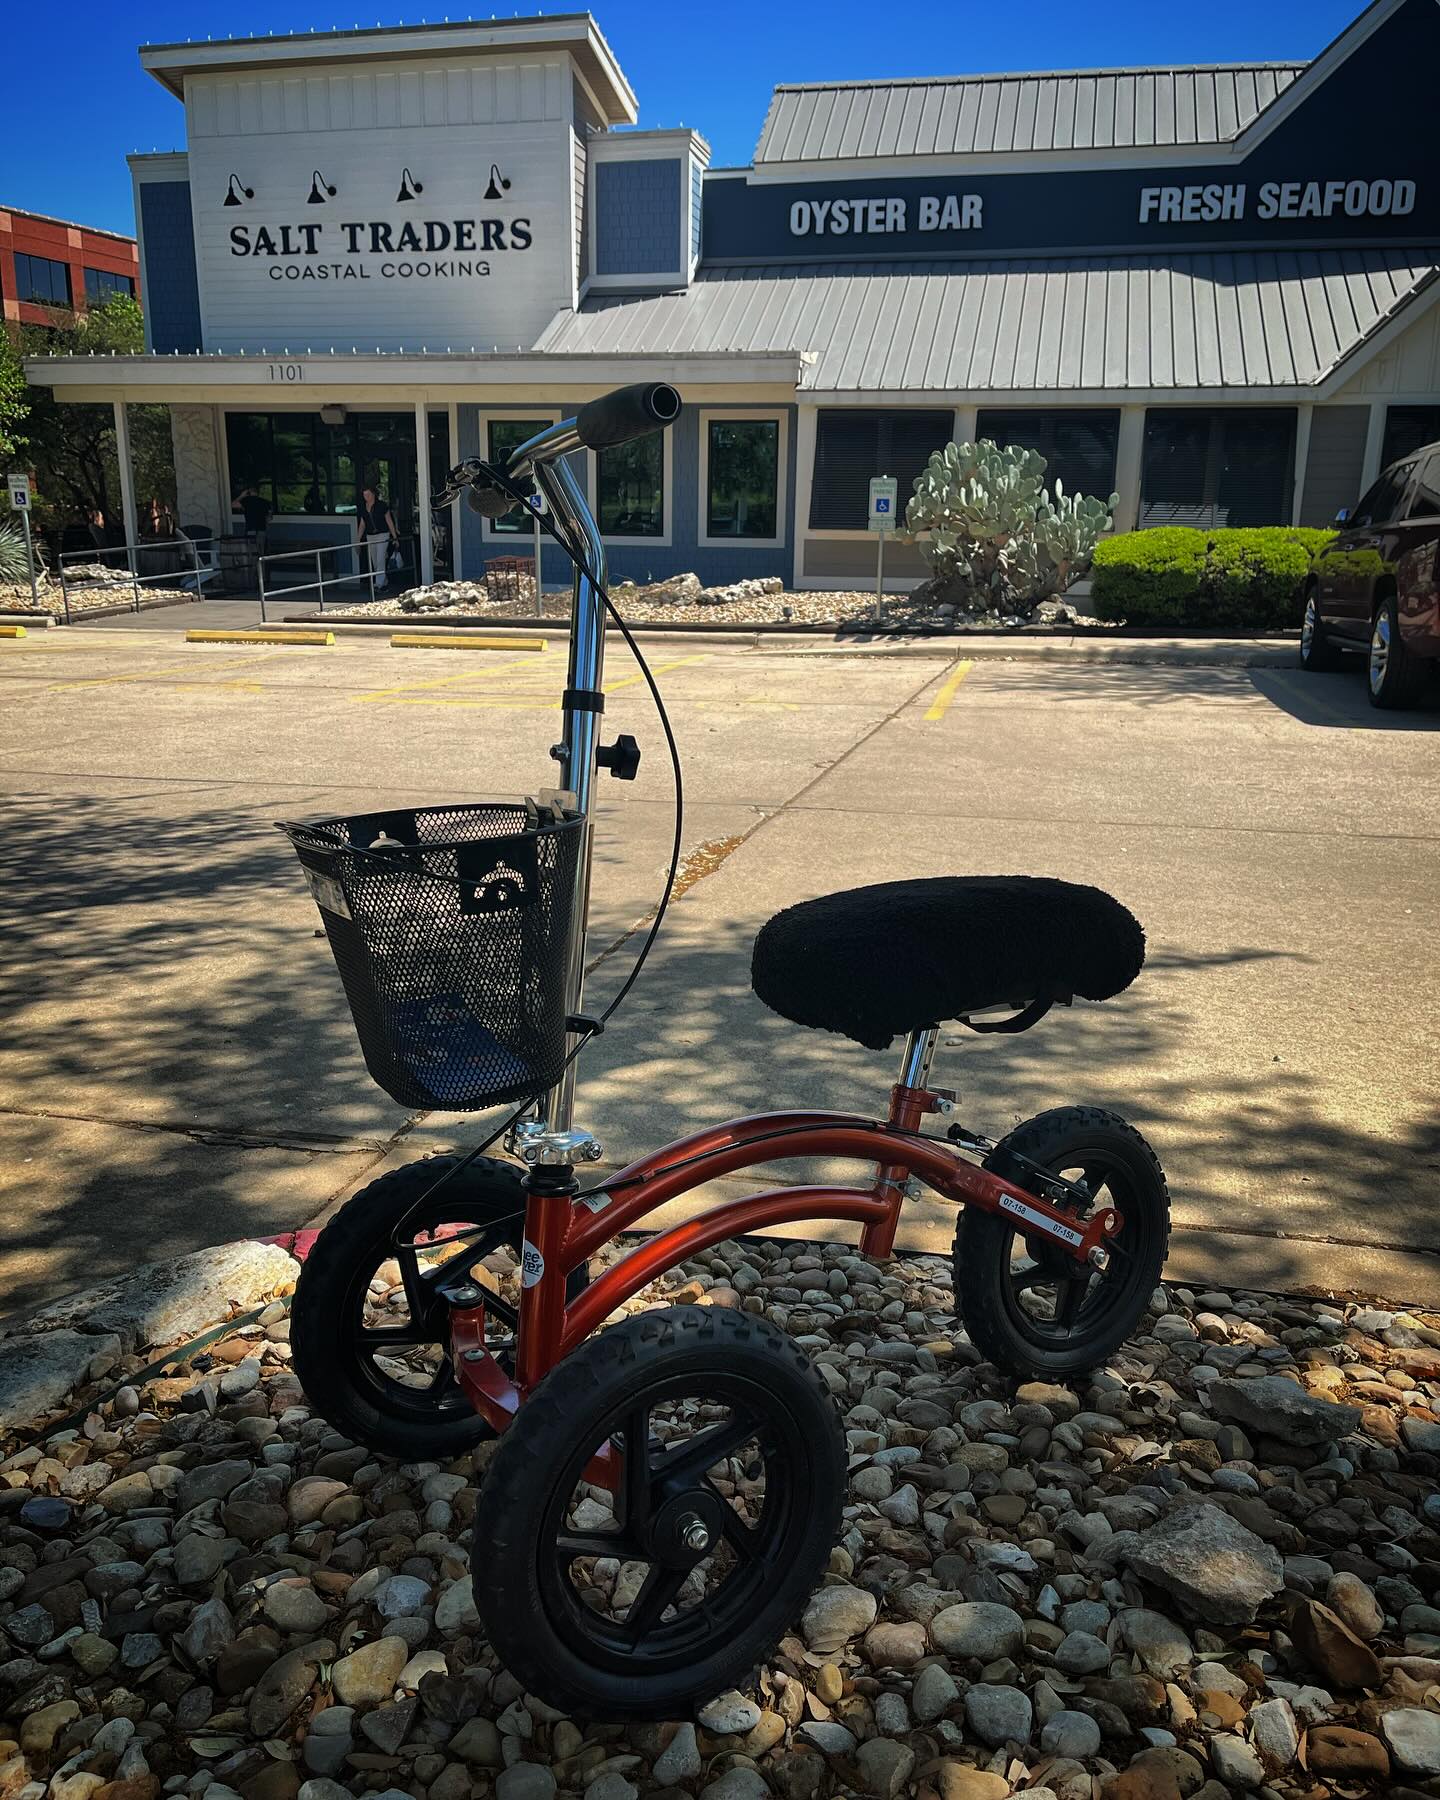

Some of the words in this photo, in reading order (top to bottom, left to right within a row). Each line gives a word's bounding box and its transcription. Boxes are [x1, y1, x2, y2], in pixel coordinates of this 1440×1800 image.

[789, 198, 907, 236] OYSTER
[918, 194, 983, 231] BAR
[1138, 183, 1247, 223] FRESH
[1256, 179, 1416, 219] SEAFOOD
[230, 223, 322, 257] SALT
[341, 218, 533, 253] TRADERS
[269, 264, 371, 280] COASTAL
[381, 261, 491, 278] COOKING
[269, 364, 303, 381] 1101
[1003, 1197, 1027, 1215] 07-158
[1053, 1224, 1075, 1240] 07-158
[524, 1250, 540, 1263] ee
